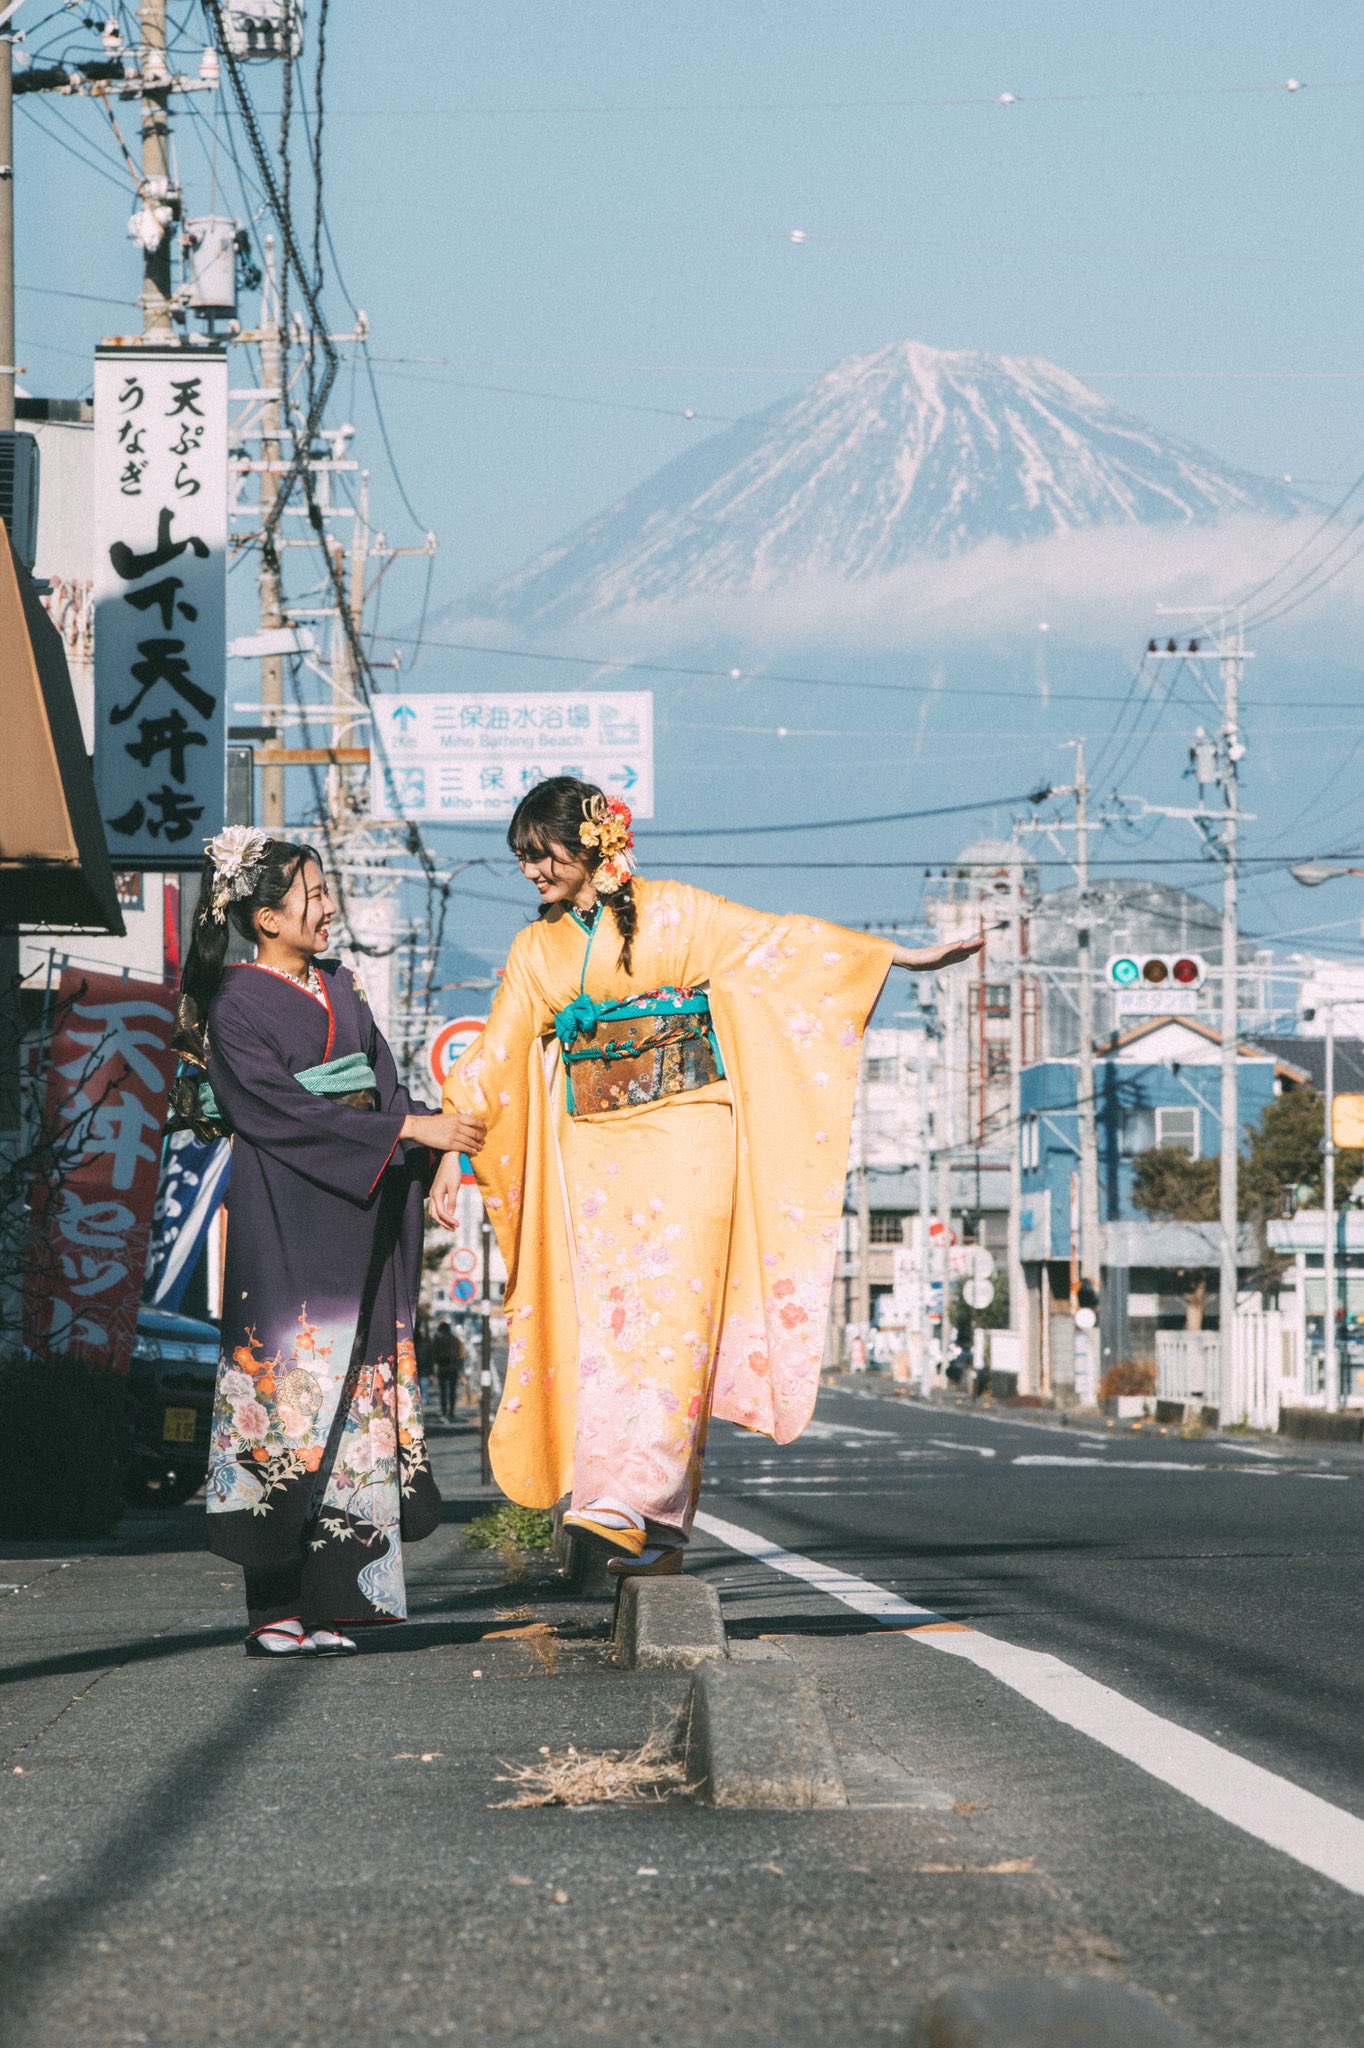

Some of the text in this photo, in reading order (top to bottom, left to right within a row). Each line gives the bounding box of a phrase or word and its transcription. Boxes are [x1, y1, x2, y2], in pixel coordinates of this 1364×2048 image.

[118, 377, 149, 496] うなぎ
[165, 377, 205, 499] 天ぷら
[106, 505, 217, 843] 山下天丼店
[432, 704, 590, 730] 三保海水浴場
[440, 733, 584, 749] Miho Bathing Beach
[50, 1001, 174, 1355] 天丼セット
